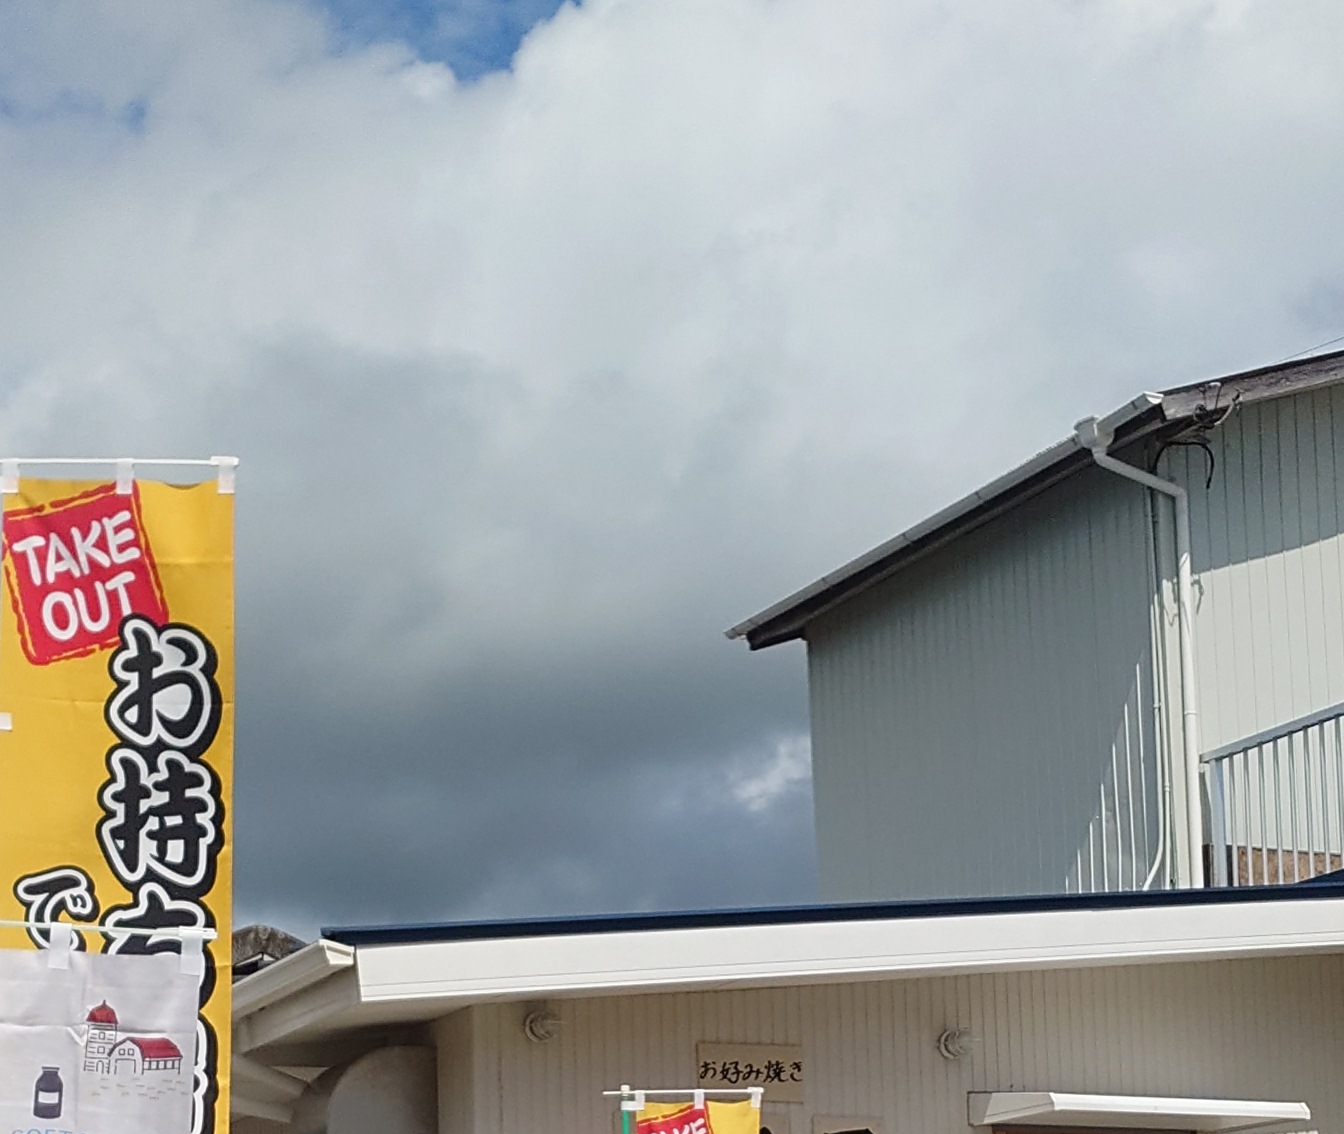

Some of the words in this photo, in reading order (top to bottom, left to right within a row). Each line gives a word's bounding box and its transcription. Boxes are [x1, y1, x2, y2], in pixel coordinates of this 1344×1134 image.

[12, 510, 141, 586] TAKE
[41, 571, 136, 641] OUT
[698, 1060, 804, 1083] お好み焼き
